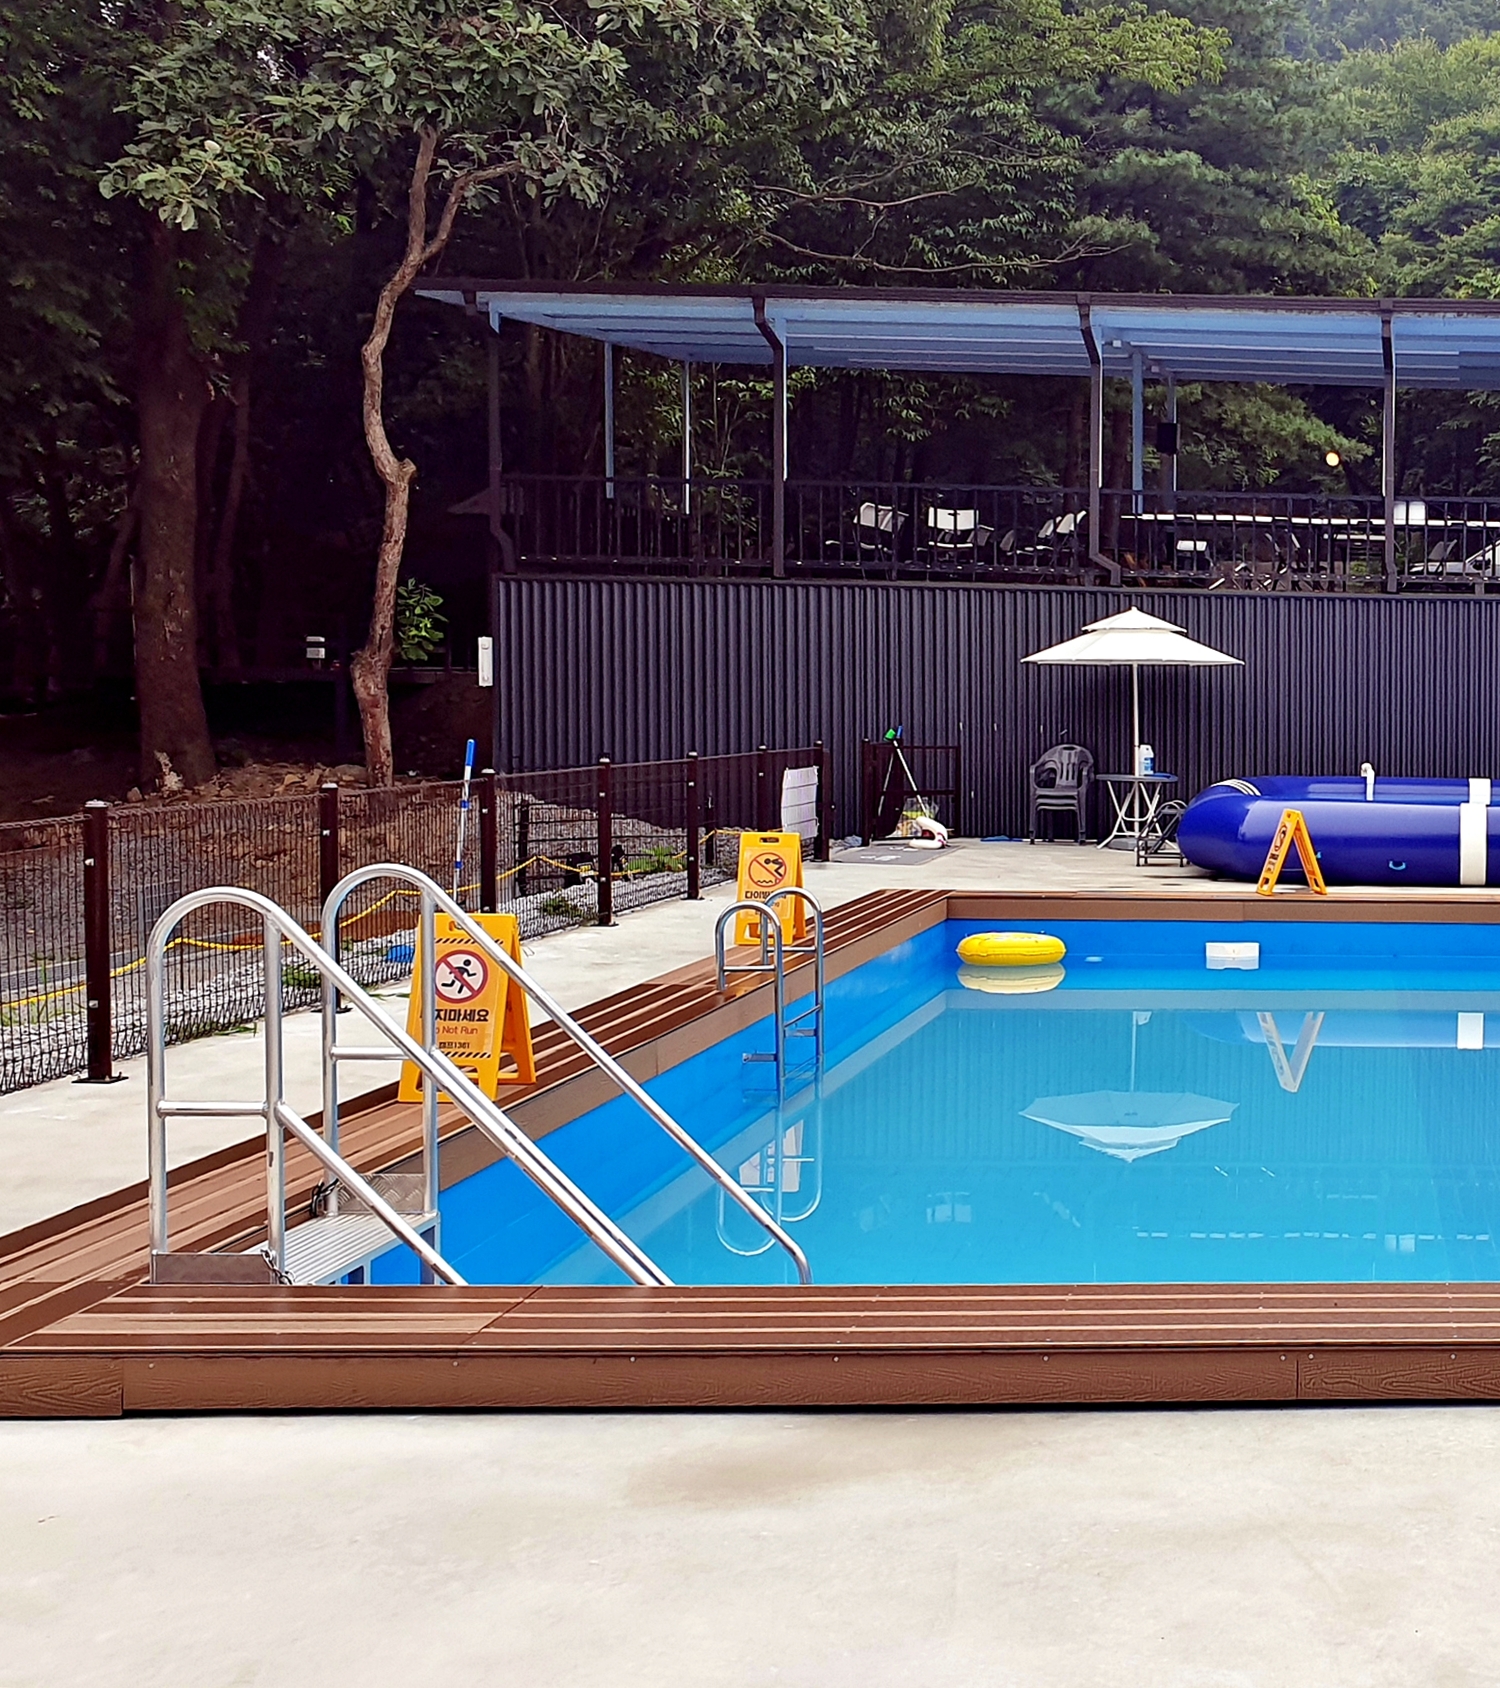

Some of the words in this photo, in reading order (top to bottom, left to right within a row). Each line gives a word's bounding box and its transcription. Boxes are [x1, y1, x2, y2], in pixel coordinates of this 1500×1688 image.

[745, 890, 786, 899] 다이빙
[420, 1008, 489, 1022] 지마세요
[442, 1026, 458, 1034] Not
[460, 1026, 478, 1034] Run
